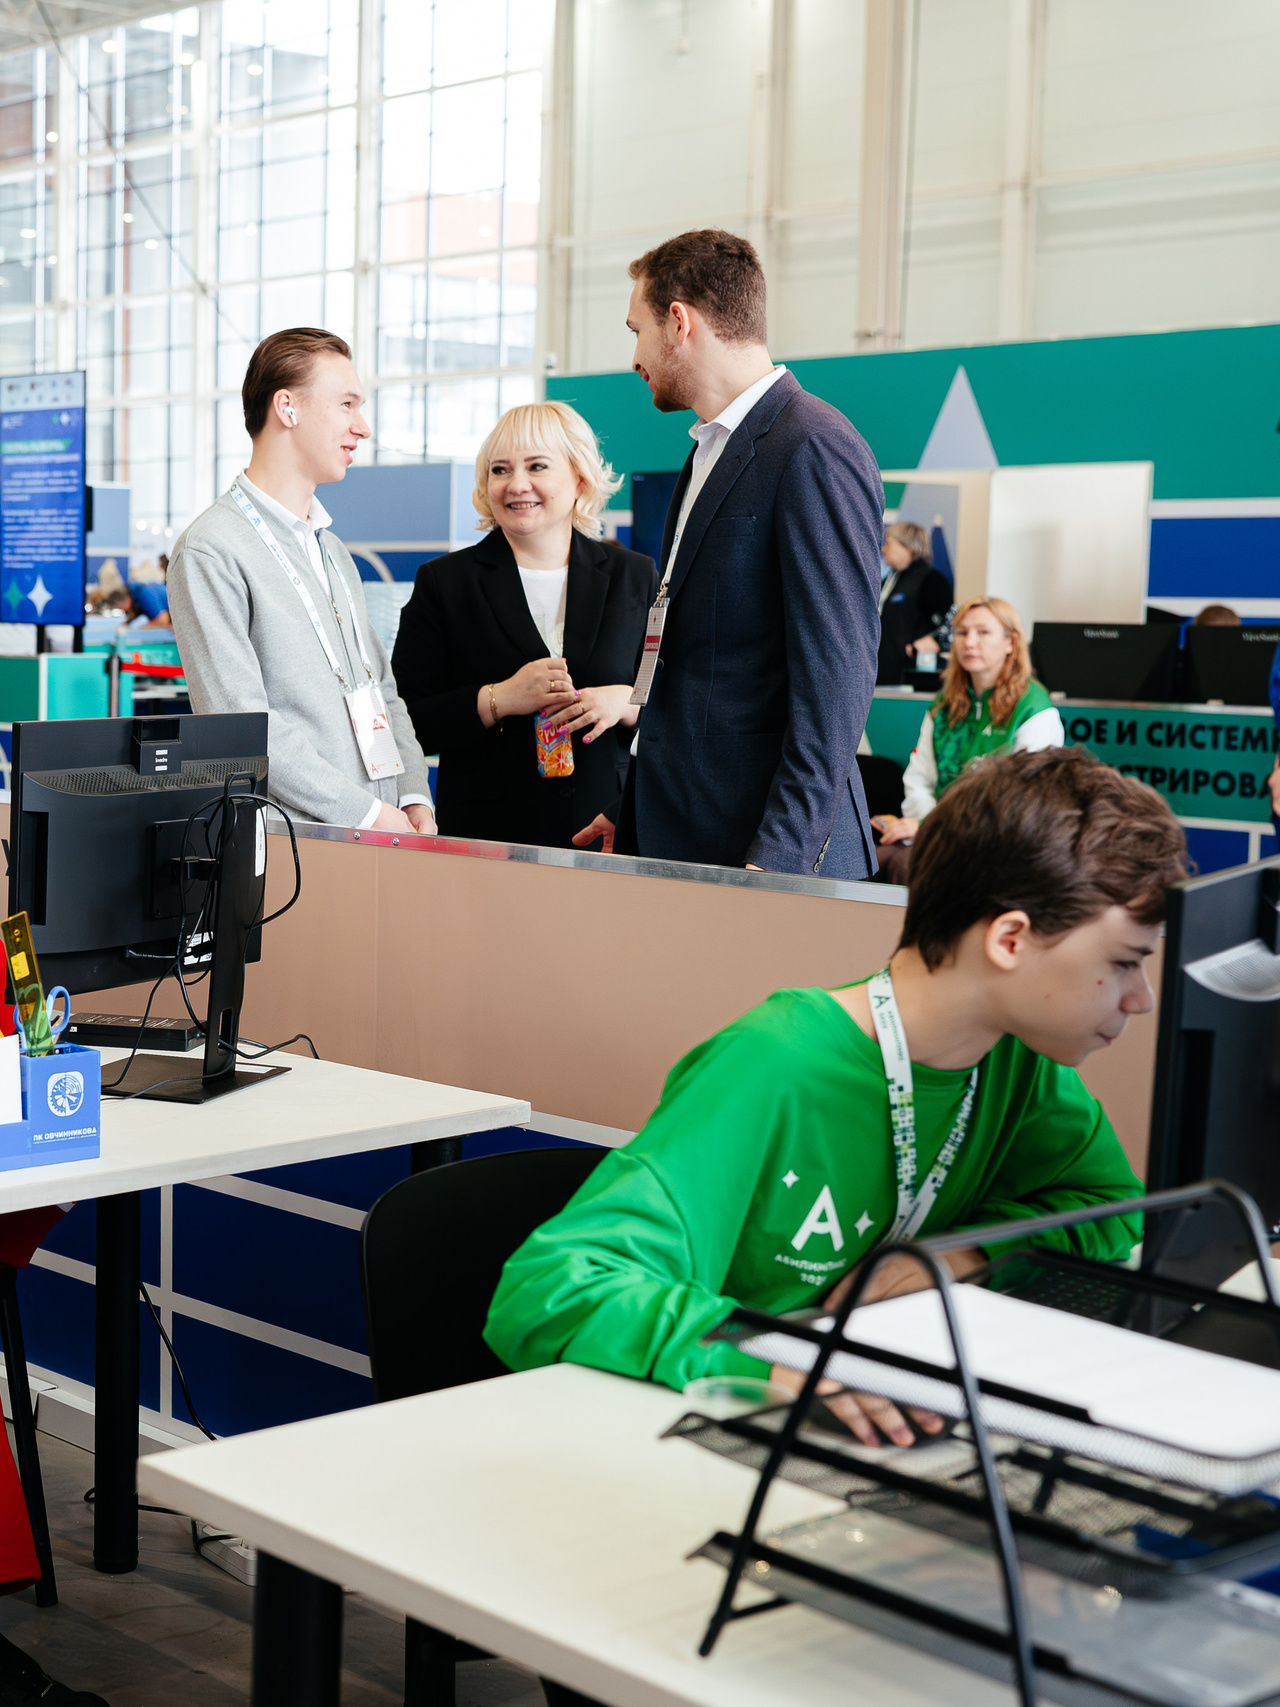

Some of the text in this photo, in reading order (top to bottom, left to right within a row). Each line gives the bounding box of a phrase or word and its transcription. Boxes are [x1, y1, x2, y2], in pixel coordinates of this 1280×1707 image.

[1116, 720, 1138, 746] И
[33, 1134, 43, 1142] ПК
[44, 1127, 97, 1140] ОВЧИННИКОВА
